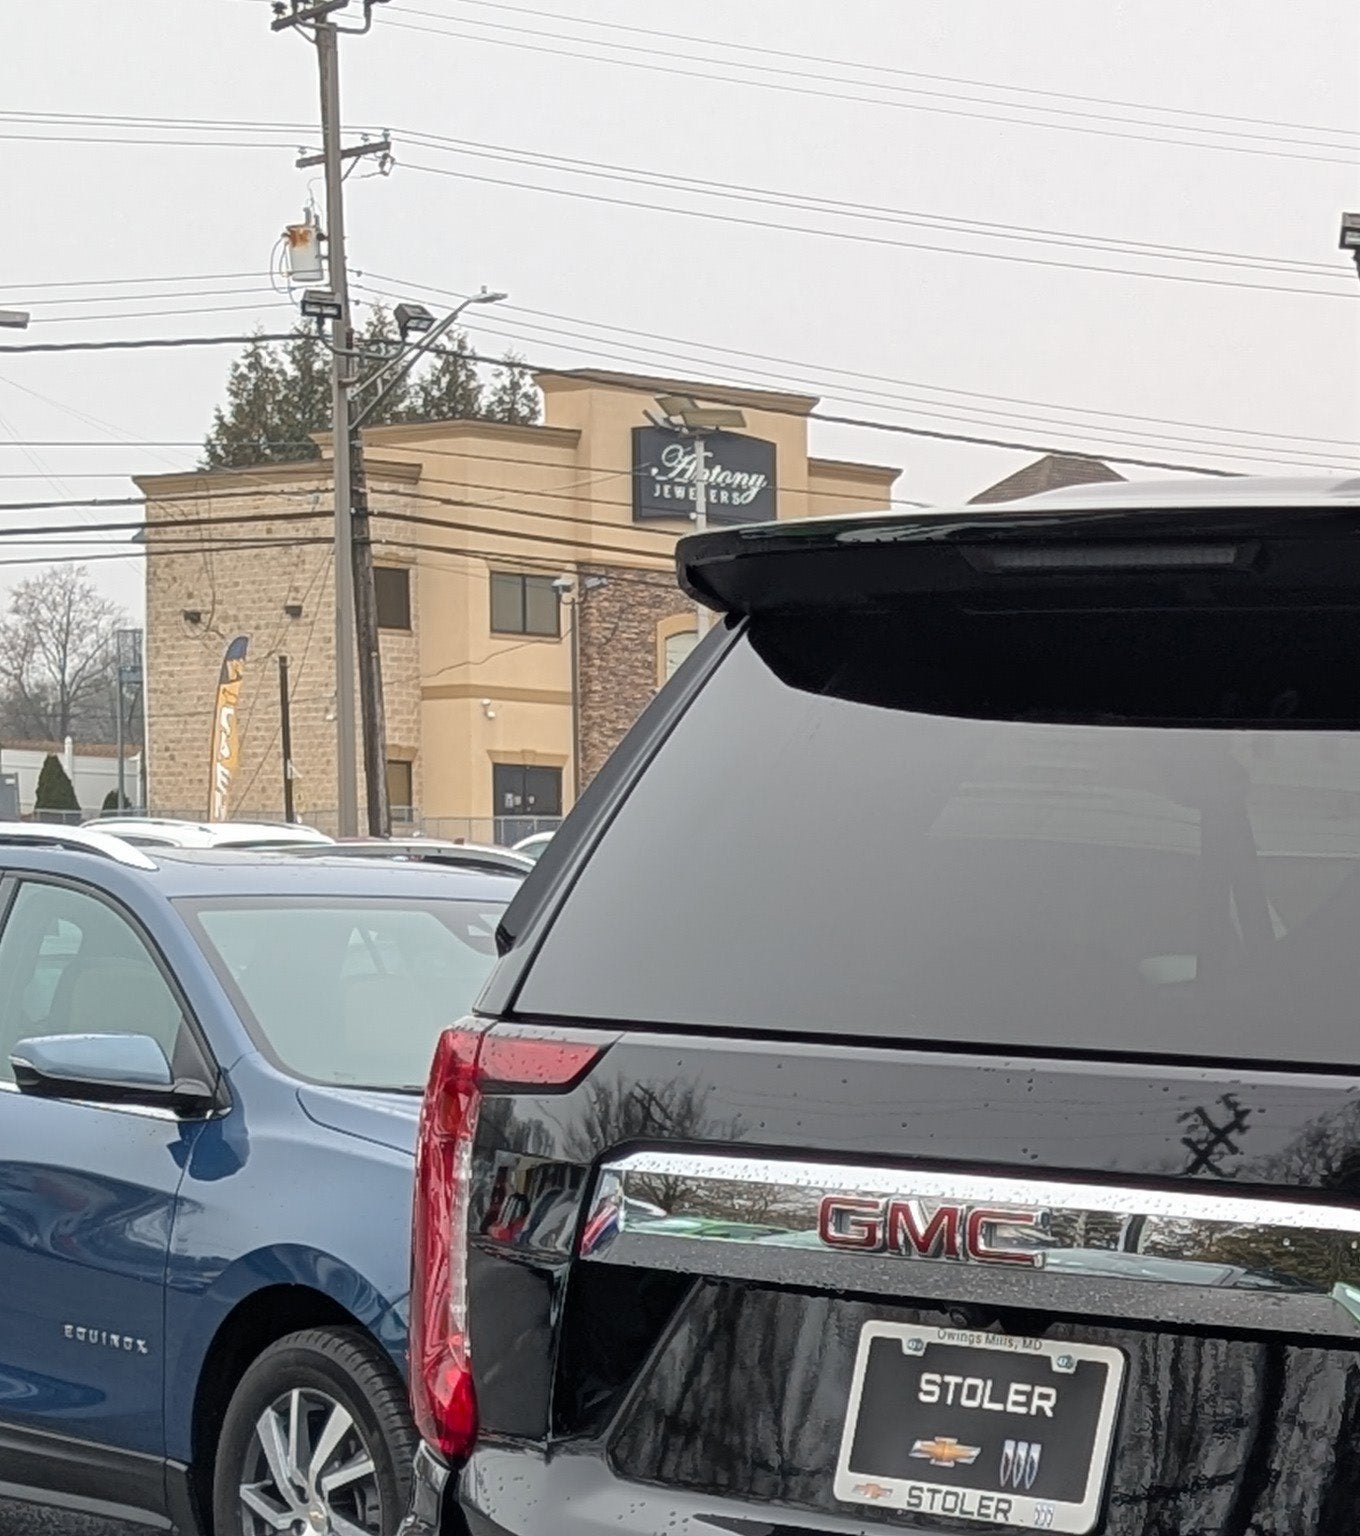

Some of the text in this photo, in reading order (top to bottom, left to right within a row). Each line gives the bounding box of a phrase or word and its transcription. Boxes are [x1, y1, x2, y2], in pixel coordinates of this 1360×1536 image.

[653, 484, 742, 505] JEWEERS
[817, 1194, 1049, 1269] GMC
[64, 1324, 148, 1354] EQUINOX
[937, 1328, 982, 1345] Owings
[1022, 1337, 1043, 1351] MD
[918, 1373, 1057, 1417] STOLER
[906, 1485, 1014, 1522] STOLER
